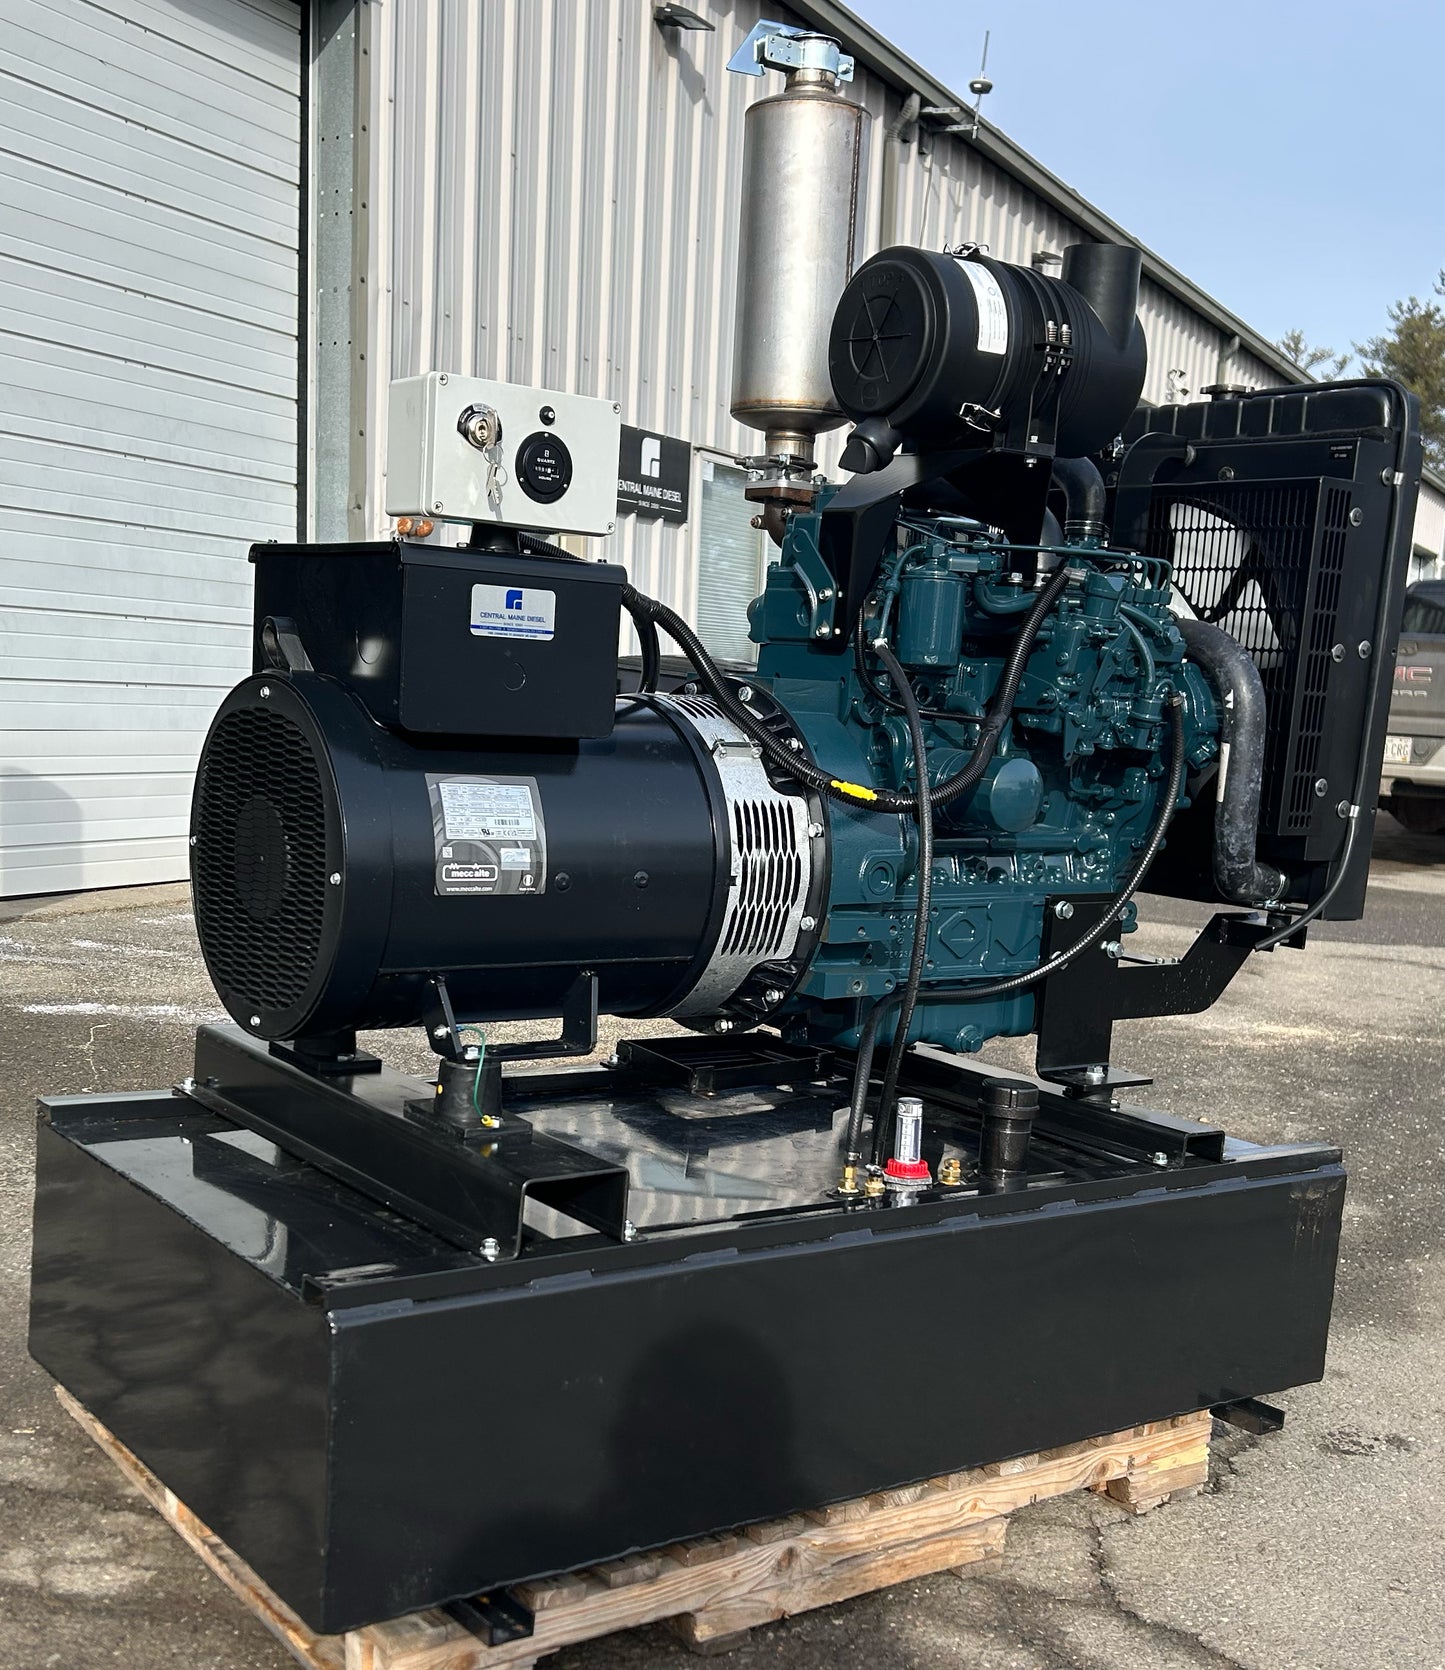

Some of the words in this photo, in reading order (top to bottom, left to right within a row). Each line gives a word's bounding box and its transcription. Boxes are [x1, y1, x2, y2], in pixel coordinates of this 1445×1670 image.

[617, 479, 642, 494] ENTRAL
[643, 484, 663, 499] MAINE
[662, 489, 682, 503] DIESEL
[480, 611, 506, 620] CENTRAL
[507, 614, 526, 622] MAINE
